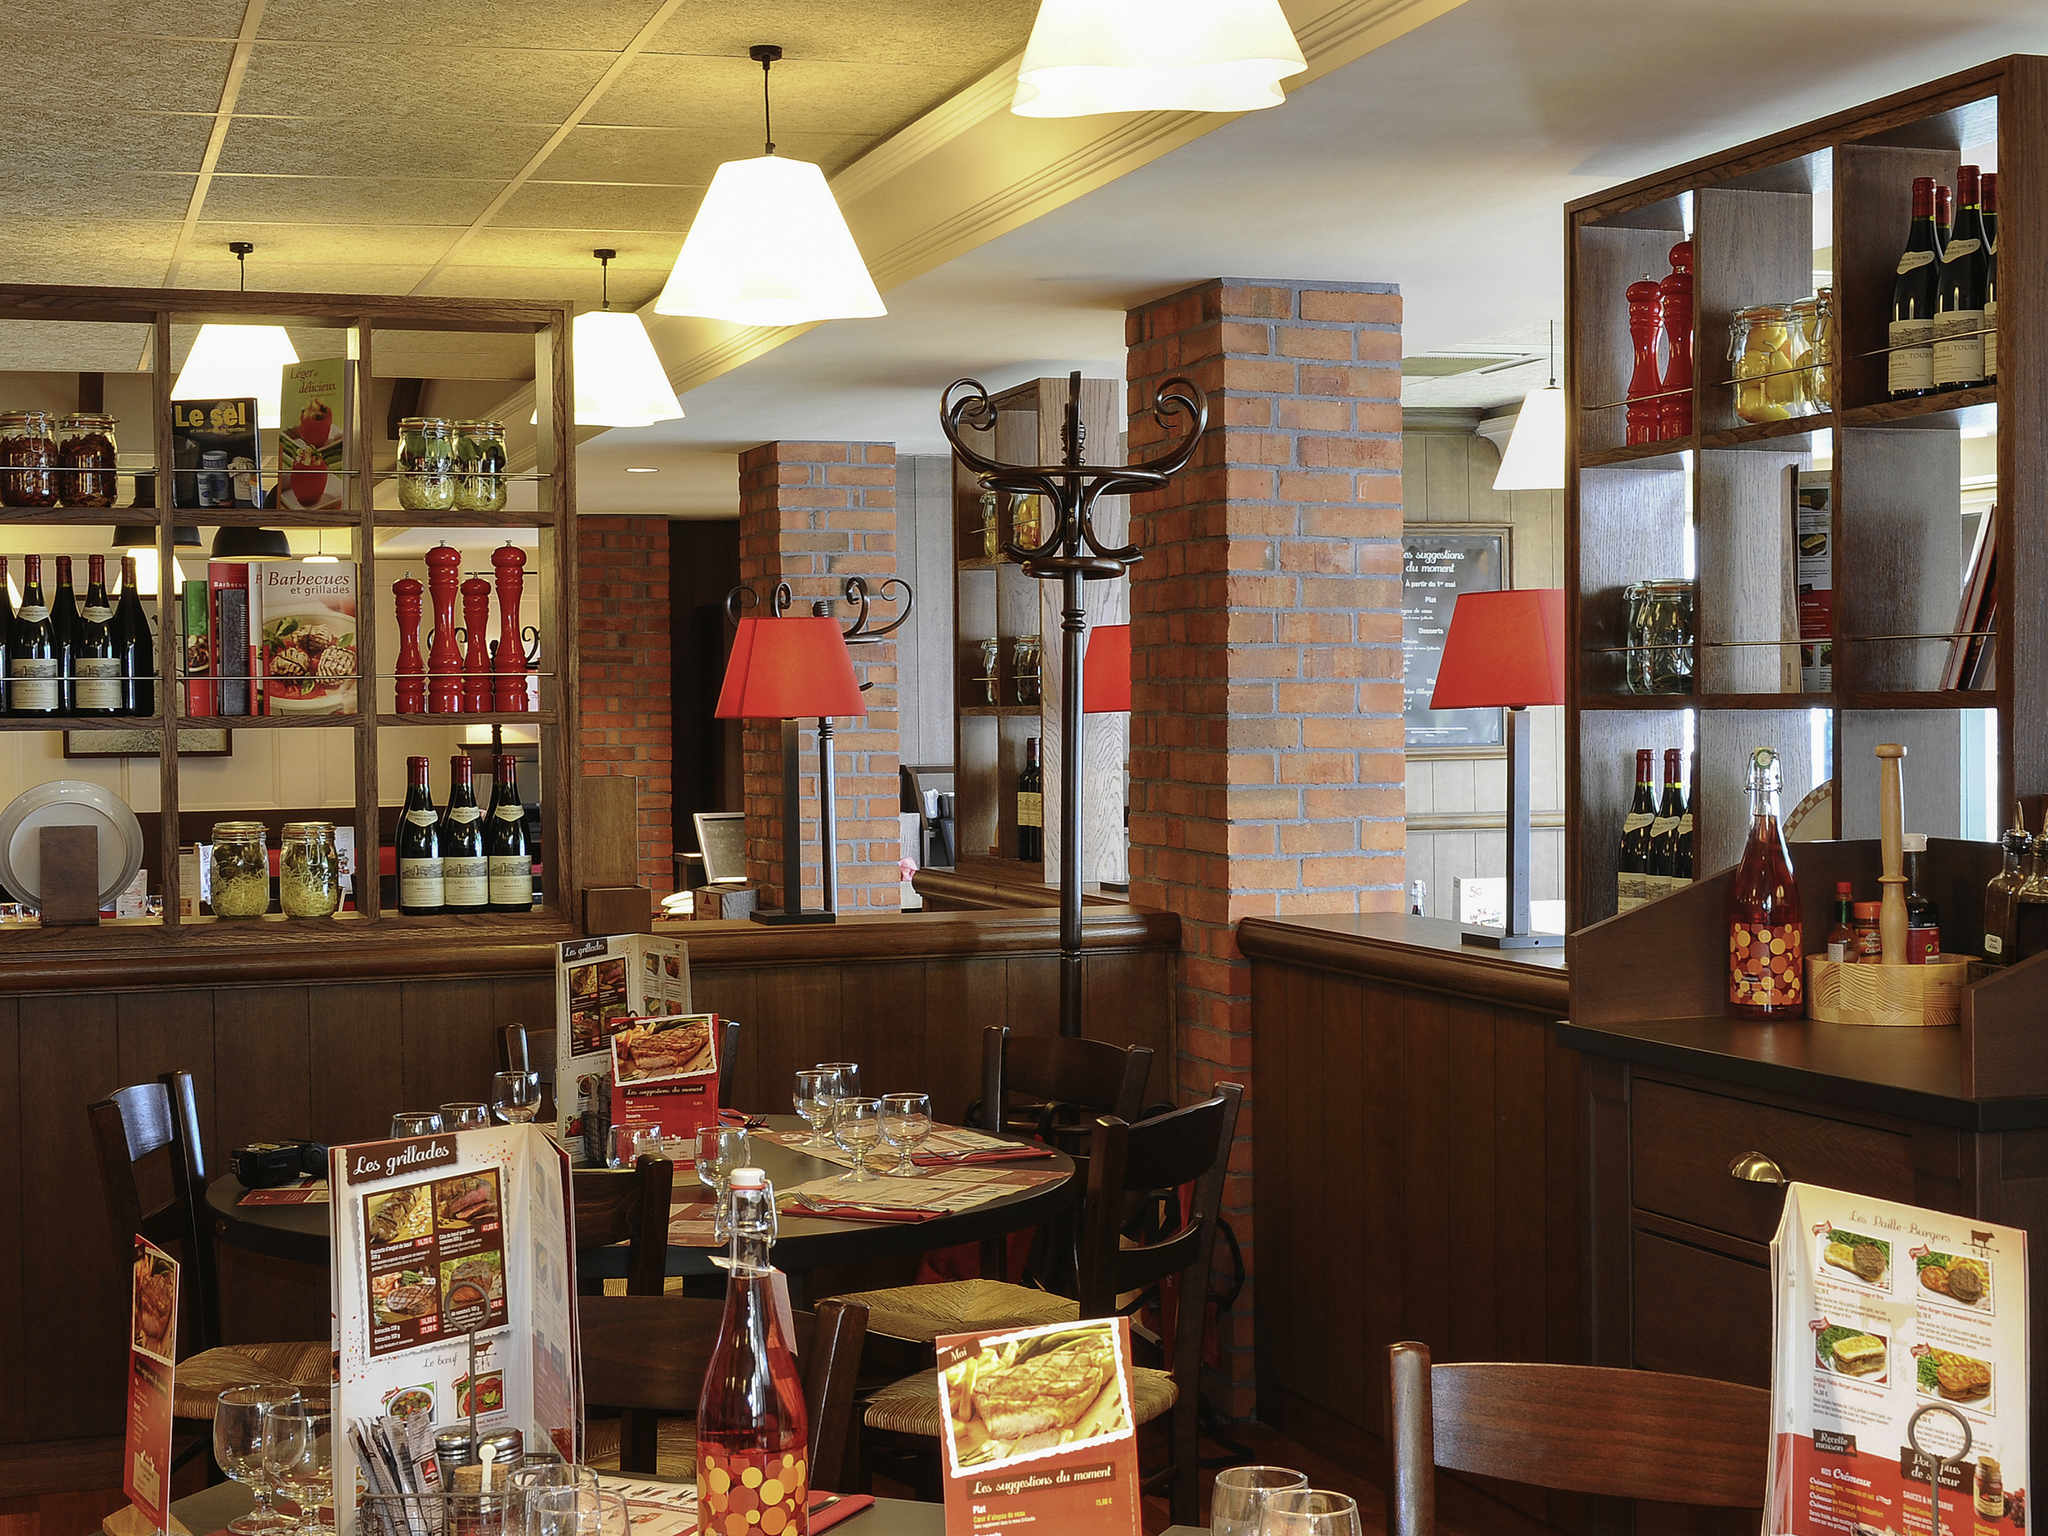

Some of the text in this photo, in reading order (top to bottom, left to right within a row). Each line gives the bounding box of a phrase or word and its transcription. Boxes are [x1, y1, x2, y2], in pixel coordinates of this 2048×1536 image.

[175, 402, 246, 427] Le sel
[1415, 550, 1465, 564] suggestions
[1405, 561, 1455, 573] du moment
[268, 570, 350, 586] Barbecues
[290, 585, 350, 597] et grillades
[353, 1141, 450, 1176] Les grillades
[1849, 1210, 1867, 1225] Les
[950, 1346, 968, 1362] Mai
[1819, 1432, 1849, 1446] Recette
[1815, 1442, 1844, 1453] maison
[1912, 1453, 1932, 1467] Pou
[973, 1465, 1111, 1495] Les suggestions du moment
[1911, 1466, 1960, 1488] de sveur
[972, 1505, 987, 1515] Plat
